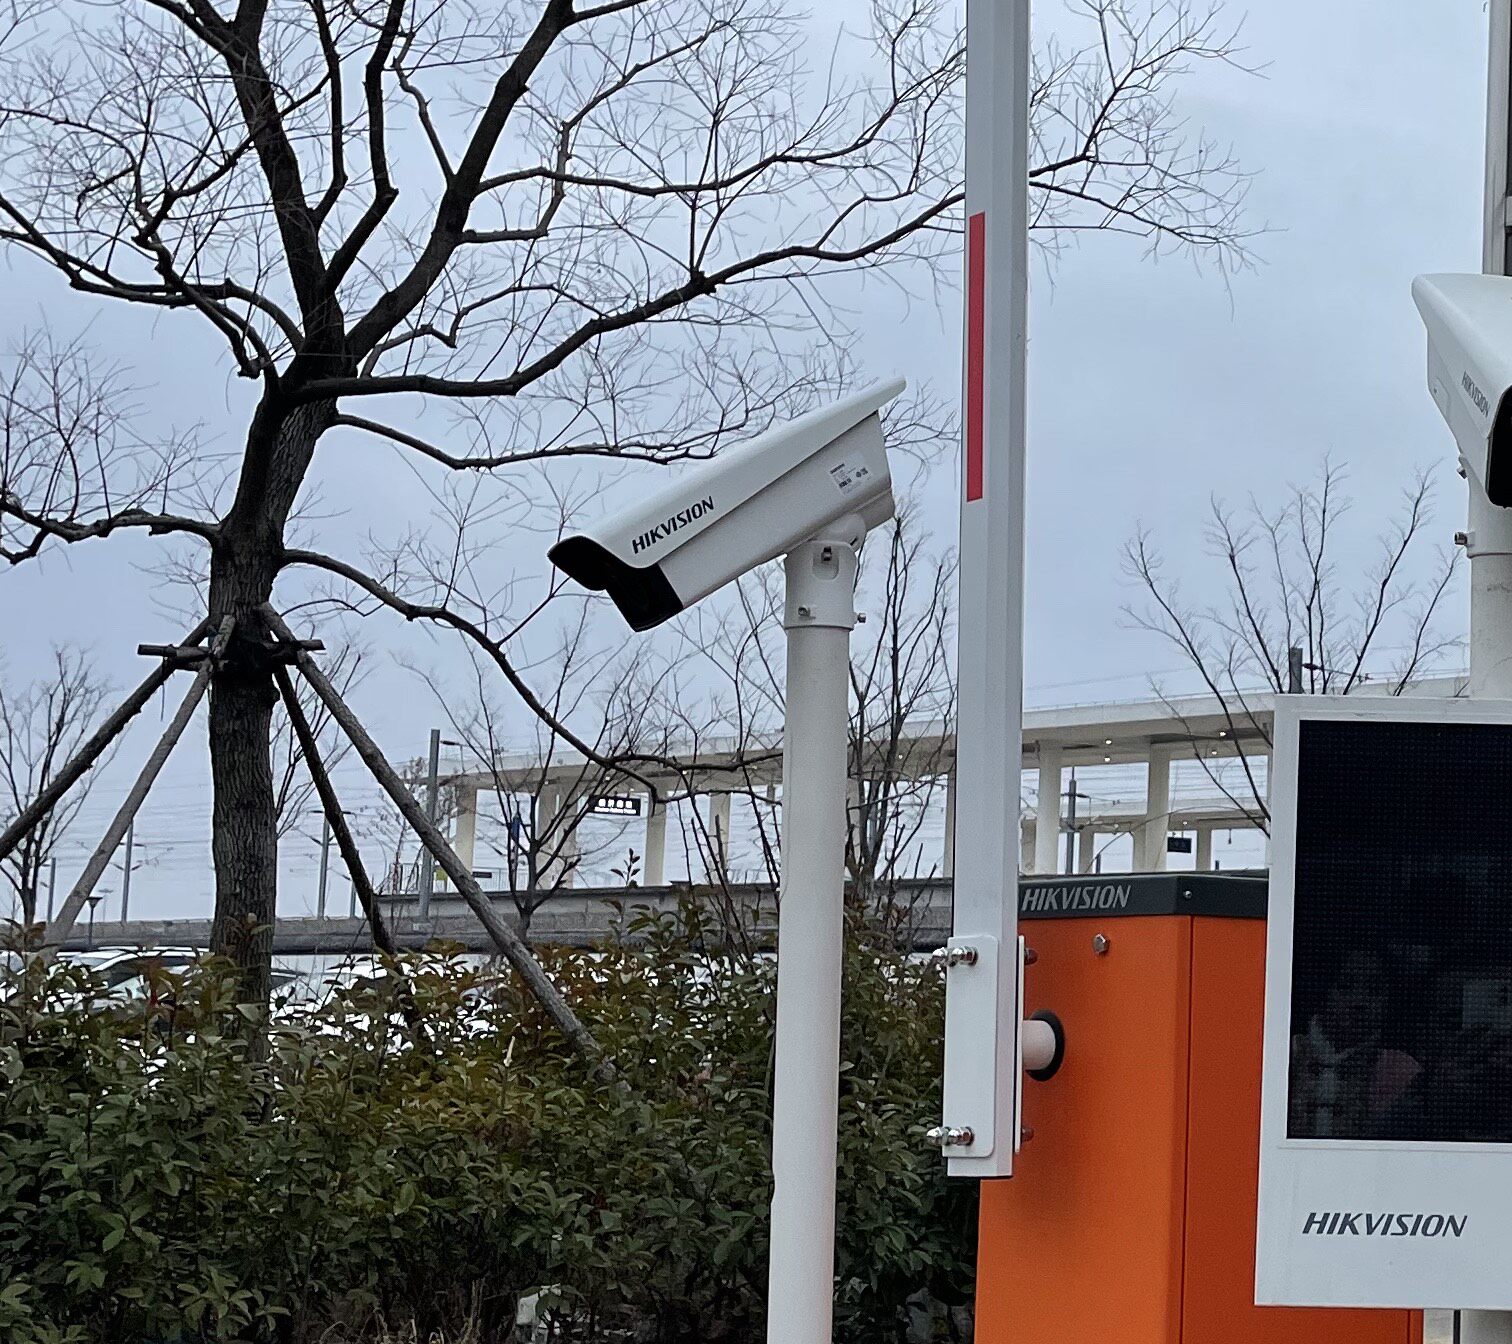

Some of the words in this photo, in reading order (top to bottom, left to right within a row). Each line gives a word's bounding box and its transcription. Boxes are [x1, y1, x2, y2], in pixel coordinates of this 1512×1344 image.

[631, 496, 715, 555] HIKVISION
[1021, 885, 1132, 911] HIKVISION
[1302, 1212, 1467, 1238] HIKVISION
